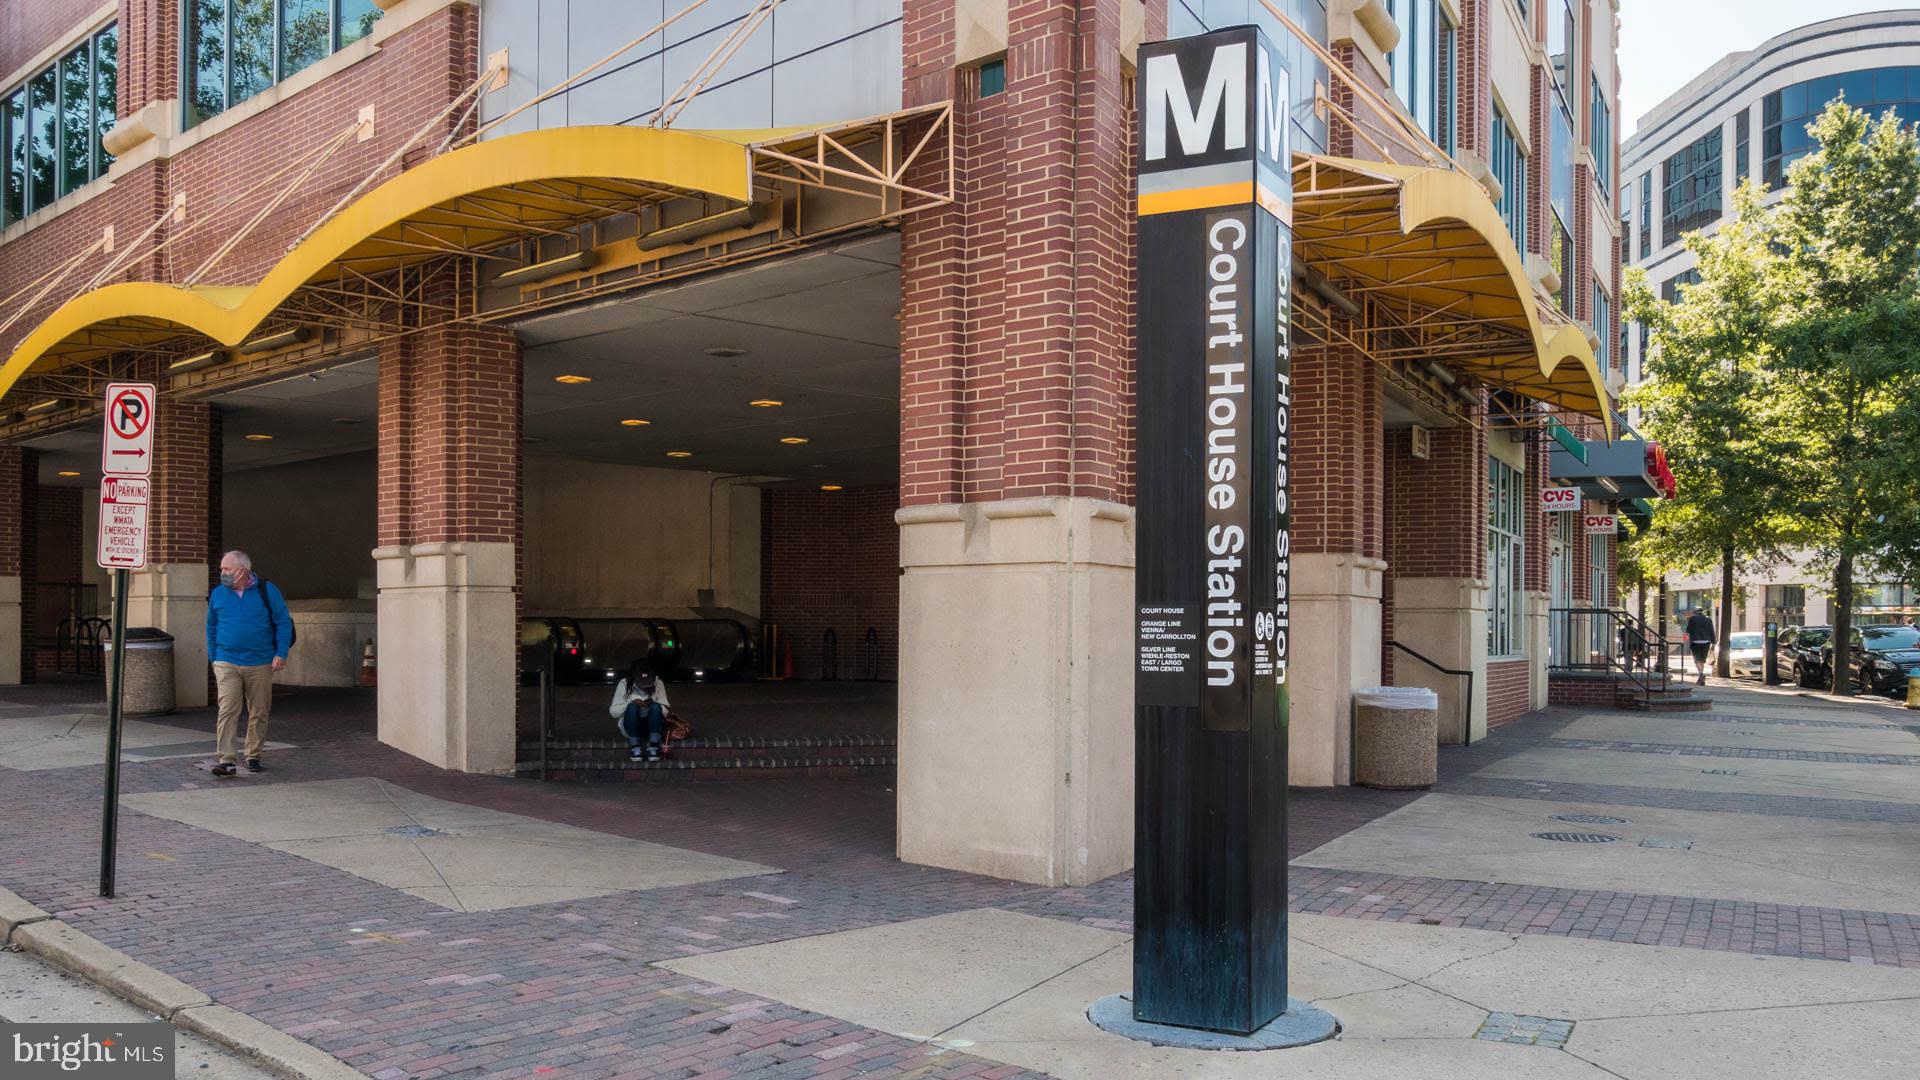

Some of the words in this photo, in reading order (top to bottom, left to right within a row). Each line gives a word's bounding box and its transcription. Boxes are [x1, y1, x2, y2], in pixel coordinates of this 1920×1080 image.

[1145, 42, 1247, 161] M
[1258, 43, 1290, 174] M
[1208, 218, 1246, 349] Court
[1277, 235, 1290, 360] Court
[103, 481, 117, 499] NO
[118, 485, 146, 498] PARKING
[1208, 362, 1245, 510] House
[1277, 373, 1290, 514] House
[104, 525, 142, 536] EMERGENCY
[110, 536, 136, 546] VEHICLE
[112, 505, 136, 515] EXCEPT
[113, 516, 134, 525] WMATA
[1543, 489, 1575, 503] CVS
[1586, 516, 1613, 527] CVS
[1207, 524, 1245, 687] Station
[1276, 528, 1289, 685] Station
